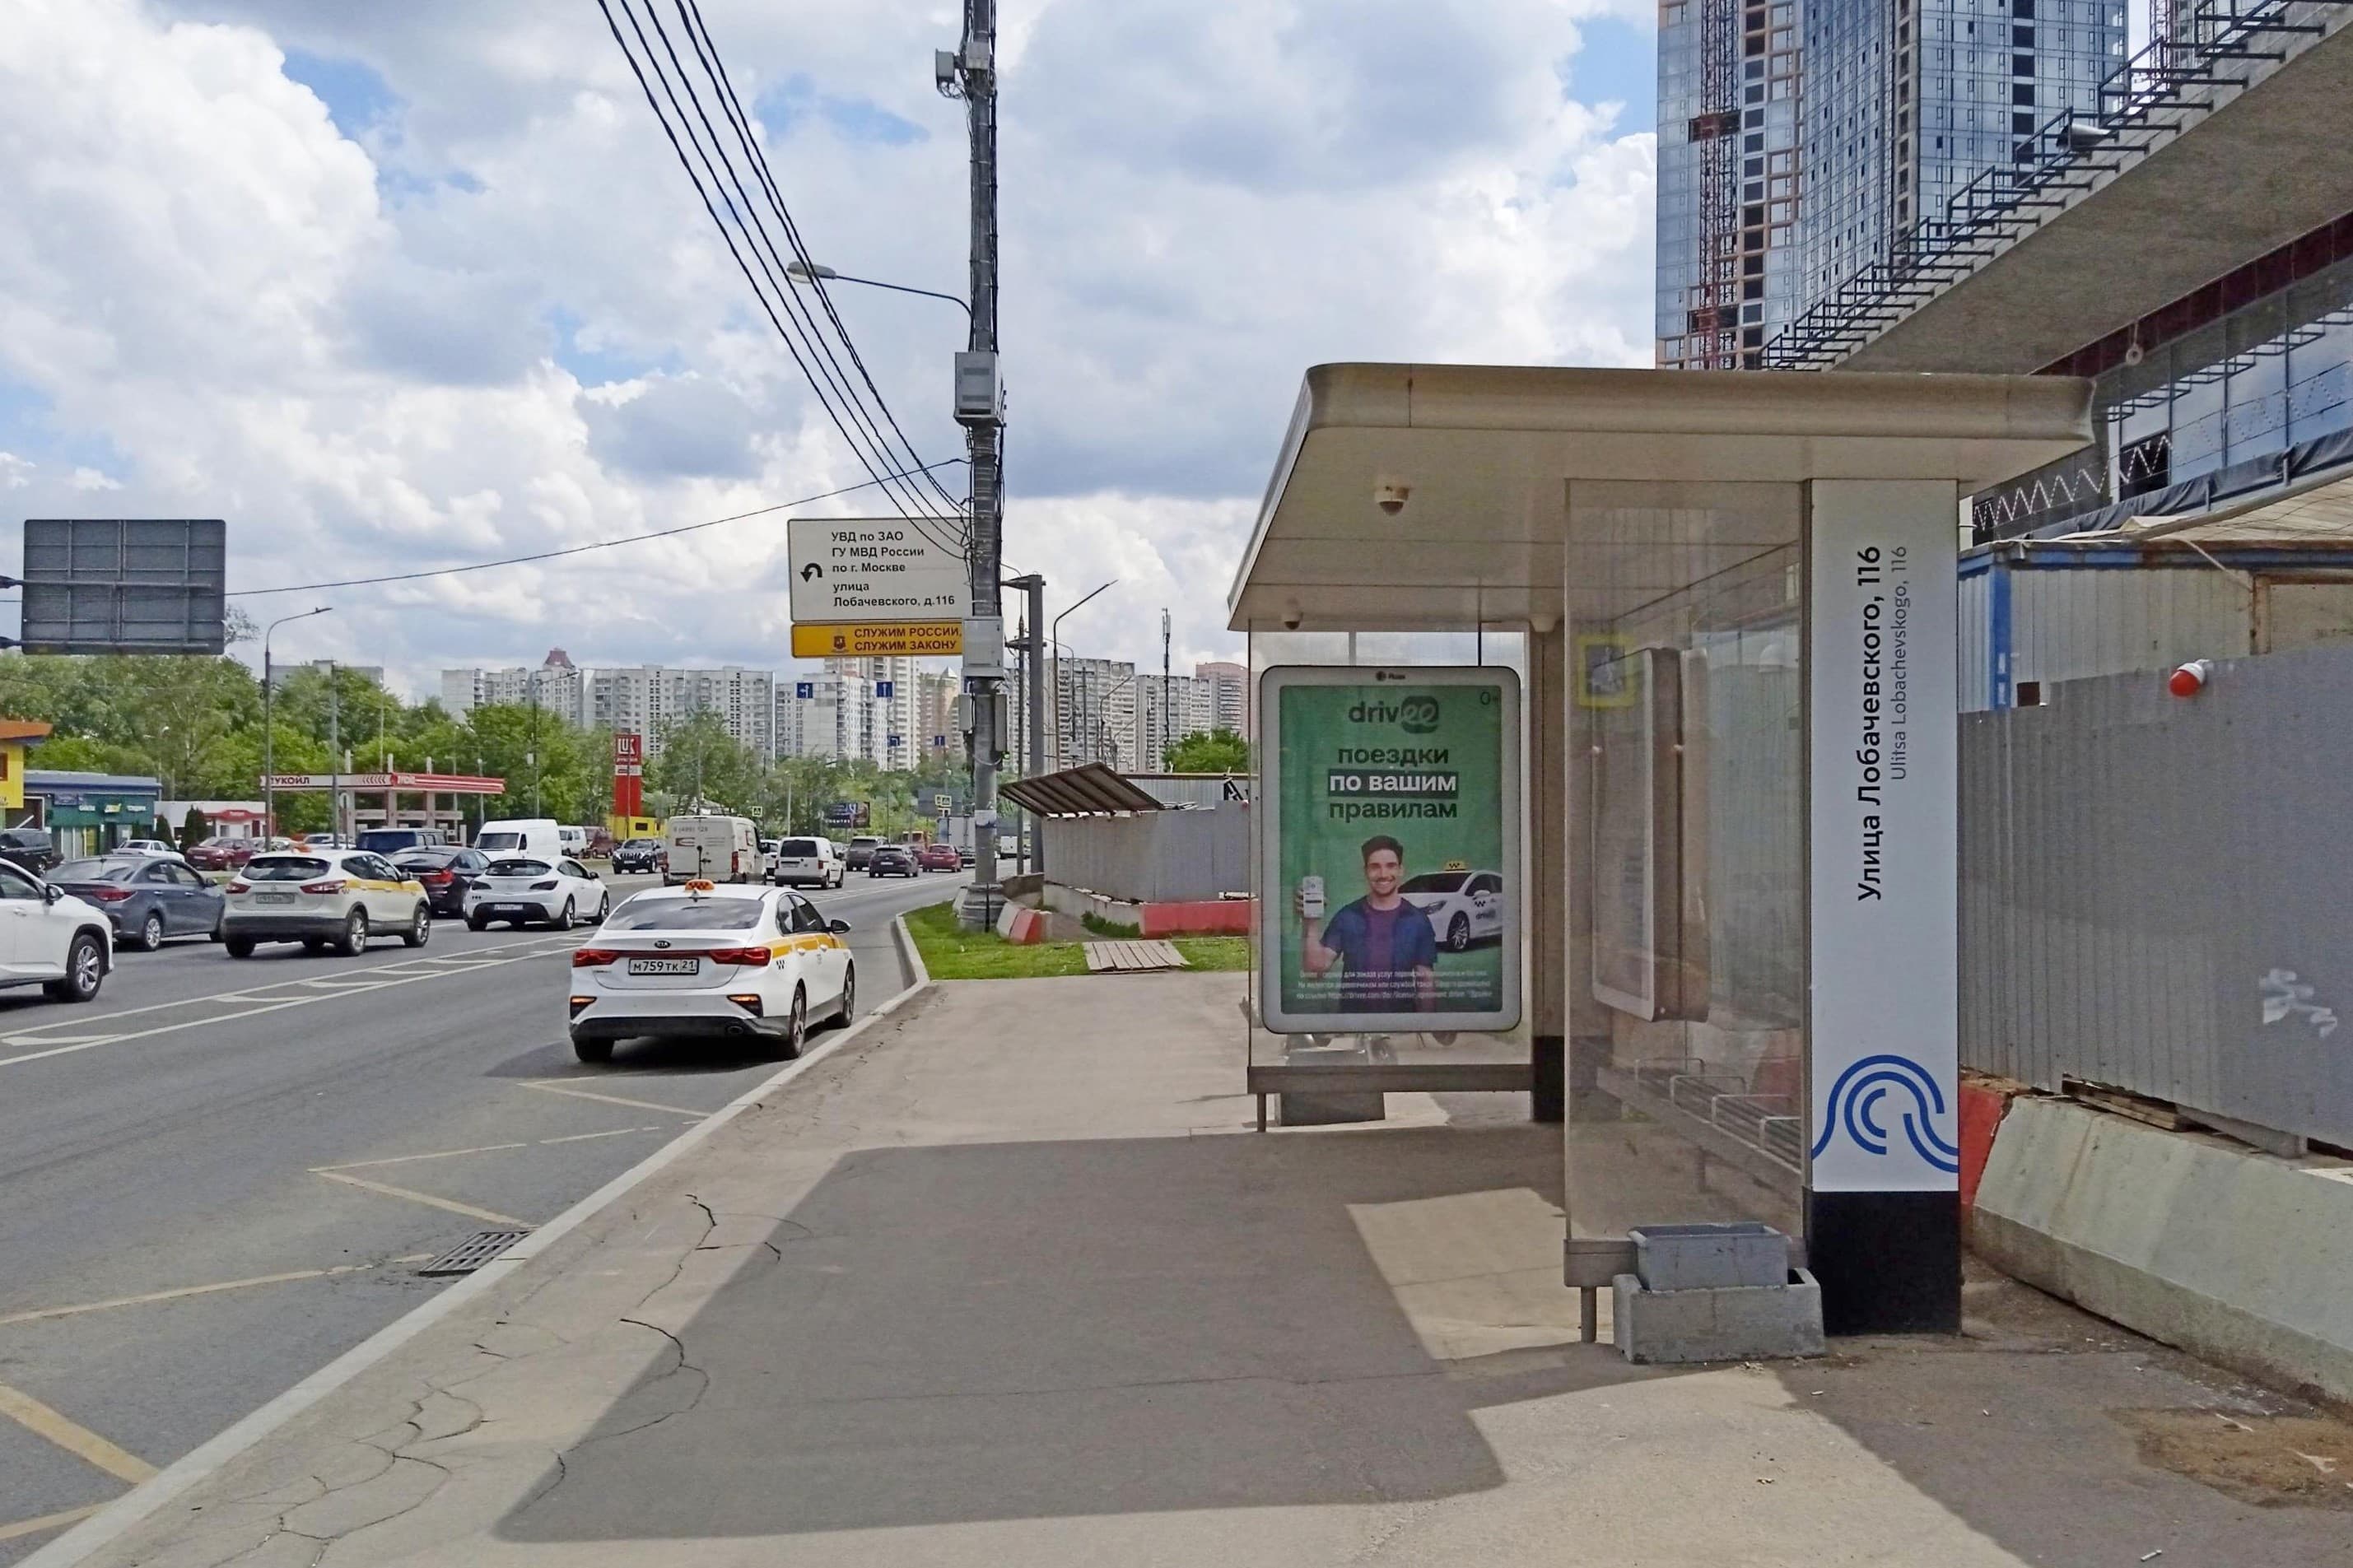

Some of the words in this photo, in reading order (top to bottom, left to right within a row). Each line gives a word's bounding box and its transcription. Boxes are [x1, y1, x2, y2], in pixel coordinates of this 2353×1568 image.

[832, 532, 856, 543] УВД
[878, 531, 903, 541] ЗАО
[832, 547, 846, 557] ГУ
[850, 547, 878, 558] МВД
[881, 547, 925, 556] России
[1891, 546, 1907, 573] 116
[861, 562, 906, 572] Москве
[1857, 546, 1881, 587] 116
[833, 584, 869, 593] улица
[833, 597, 920, 607] Лобачевского,
[924, 595, 955, 607] д.116
[855, 628, 906, 638] СЛУЖИМ
[855, 642, 906, 651] СЛУЖИМ
[910, 640, 957, 649] ЗАКОНУ
[1891, 579, 1910, 724] Lobachevskogo,
[1857, 595, 1884, 806] Лобачевского,
[1338, 747, 1450, 766] поездки
[1891, 732, 1907, 780] Ulitsa
[1330, 774, 1361, 792] по
[1369, 774, 1456, 792] вашим
[1329, 803, 1457, 823] правилам
[1857, 815, 1883, 901] Улица
[682, 961, 694, 970] 21
